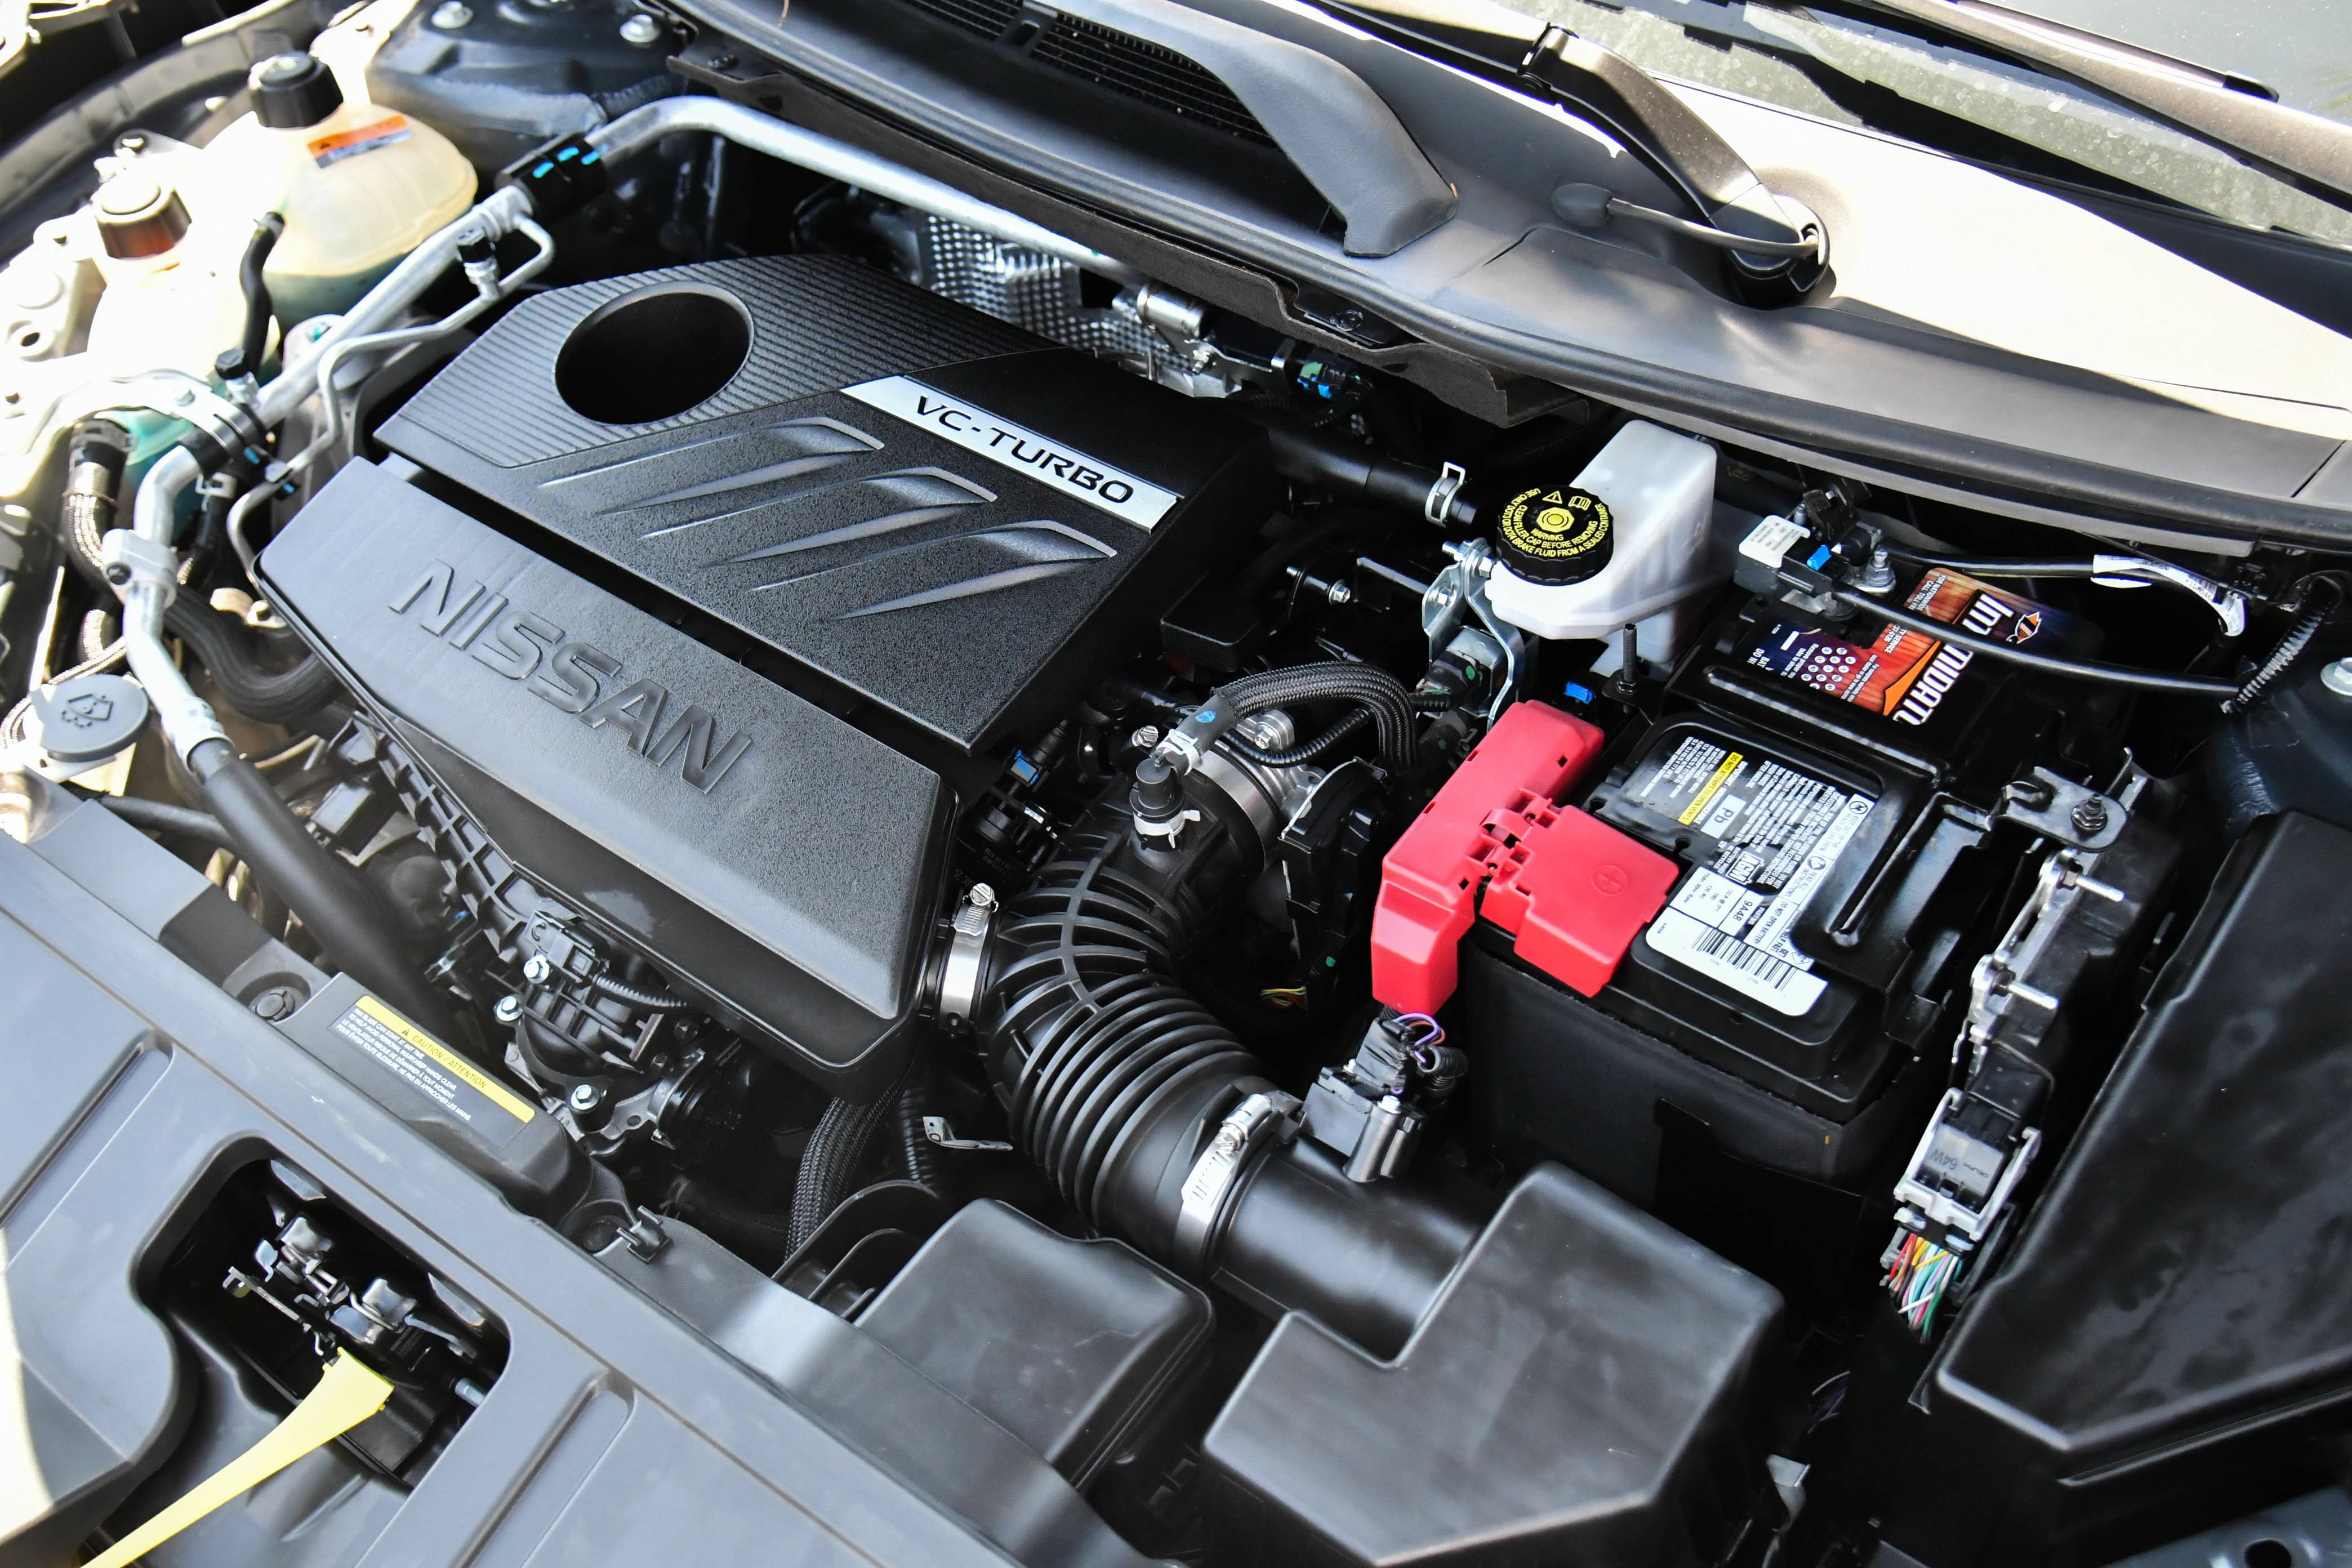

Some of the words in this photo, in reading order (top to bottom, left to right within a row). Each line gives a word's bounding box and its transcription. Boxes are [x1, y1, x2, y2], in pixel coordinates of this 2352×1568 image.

[916, 395, 1134, 503] VC-TURBO
[1511, 494, 1527, 506] ONLY
[1525, 488, 1541, 498] USE
[1503, 505, 1516, 519] DOT3
[1513, 505, 1528, 522] CLEAN
[1594, 502, 1609, 532] CONTAINER
[1503, 526, 1516, 541] DOT4
[1513, 522, 1529, 539] FILLER
[1531, 528, 1563, 541] WARNING
[1572, 520, 1598, 546] REMOVING
[1512, 538, 1536, 554] BRAKE
[1526, 536, 1542, 545] CAP
[1541, 540, 1573, 549] BEFORE
[1584, 531, 1605, 549] SEALED
[1534, 549, 1556, 557] FLUID
[1557, 549, 1579, 557] FROM
[1935, 574, 1946, 584] FOR
[1915, 583, 1941, 611] NATIONWIDE
[1883, 634, 1903, 653] SERVICE
[1752, 648, 1765, 658] DO
[389, 558, 752, 795] NISSAN
[1722, 760, 1734, 770] NOT
[1707, 769, 1727, 789] ATTEMPT
[1693, 794, 1707, 807] OPEN
[1713, 808, 1734, 825] Pb
[1727, 853, 1761, 881] AGM
[1730, 899, 1754, 921] 9A48
[1772, 907, 1784, 916] NOT
[1764, 916, 1777, 927] OPEN
[1750, 926, 1769, 945] BATTERY
[1775, 948, 1789, 958] GET
[353, 1006, 364, 1017] FAN
[362, 1013, 377, 1027] BLADE
[375, 1022, 386, 1033] CAN
[385, 1029, 400, 1043] START
[397, 1038, 405, 1046] AT
[403, 1041, 415, 1053] ANY
[341, 1017, 350, 1026] LE
[373, 1040, 391, 1056] RISQUE
[389, 1052, 398, 1061] DE
[422, 1074, 435, 1086] TOUT
[348, 1012, 357, 1021] TO
[354, 1017, 367, 1029] HELP
[364, 1024, 380, 1037] AVOID
[377, 1033, 400, 1053] PERSONAL
[425, 1066, 442, 1081] HANDS
[336, 1023, 350, 1036] POUR
[362, 1041, 377, 1055] TOUTE
[398, 1067, 406, 1075] NE
[404, 1071, 416, 1082] PAS
[413, 1077, 421, 1086] EN
[420, 1081, 449, 1105] APPROCHER
[446, 1101, 457, 1111] LES
[411, 1034, 443, 1059] CAUTION
[448, 1057, 487, 1089] ATTENTION
